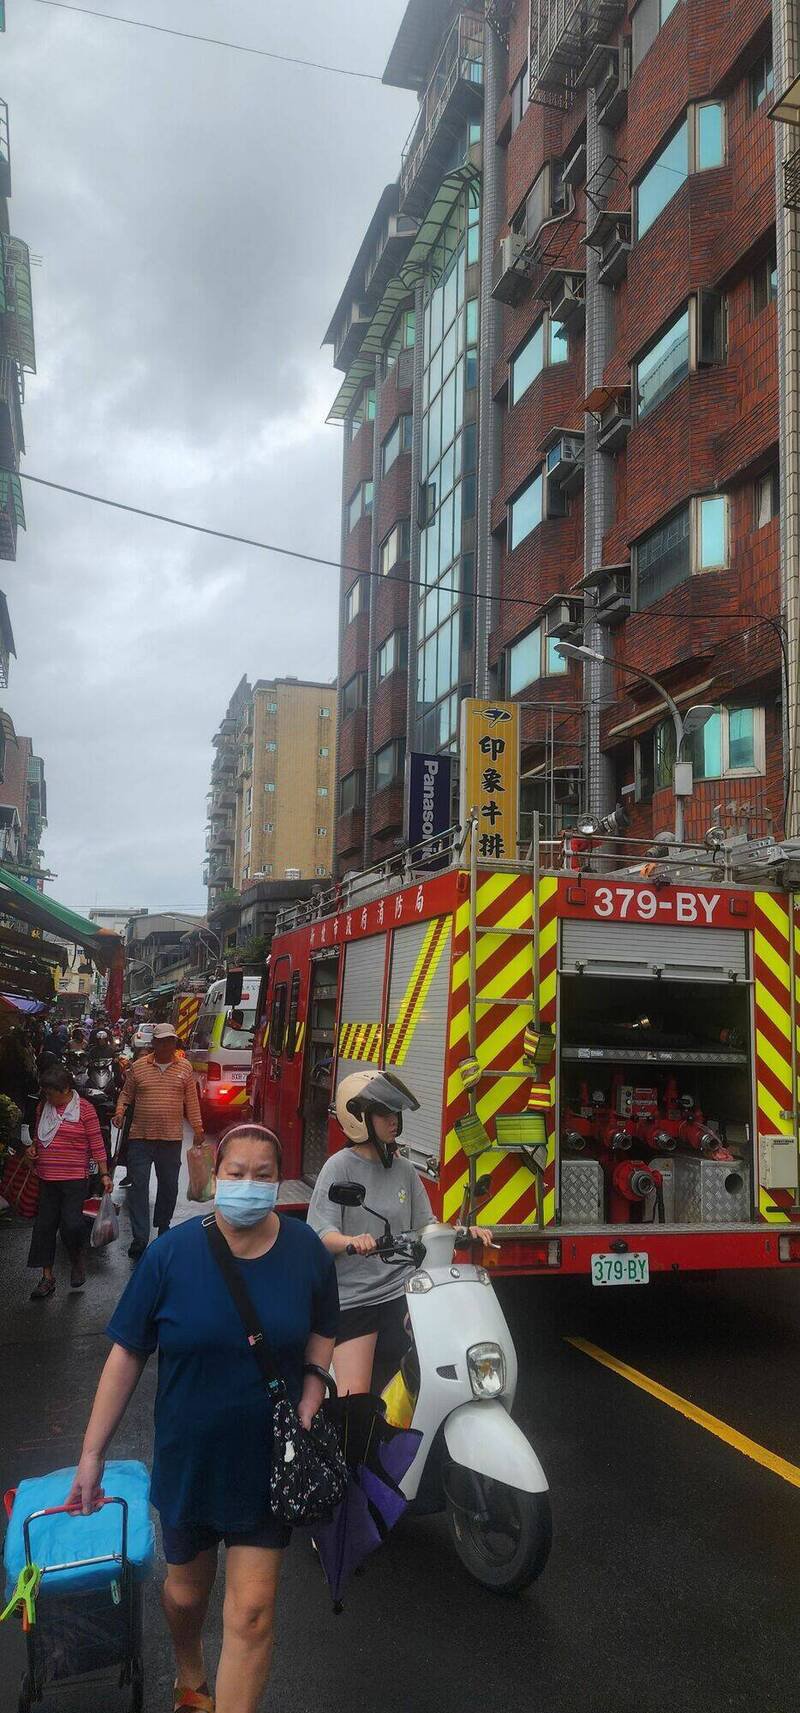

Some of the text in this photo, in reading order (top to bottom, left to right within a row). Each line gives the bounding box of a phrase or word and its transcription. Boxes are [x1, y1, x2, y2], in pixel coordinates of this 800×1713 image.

[478, 735, 506, 859] 印象牛排
[593, 887, 720, 923] 379-BY
[594, 1259, 647, 1281] 379-BY
